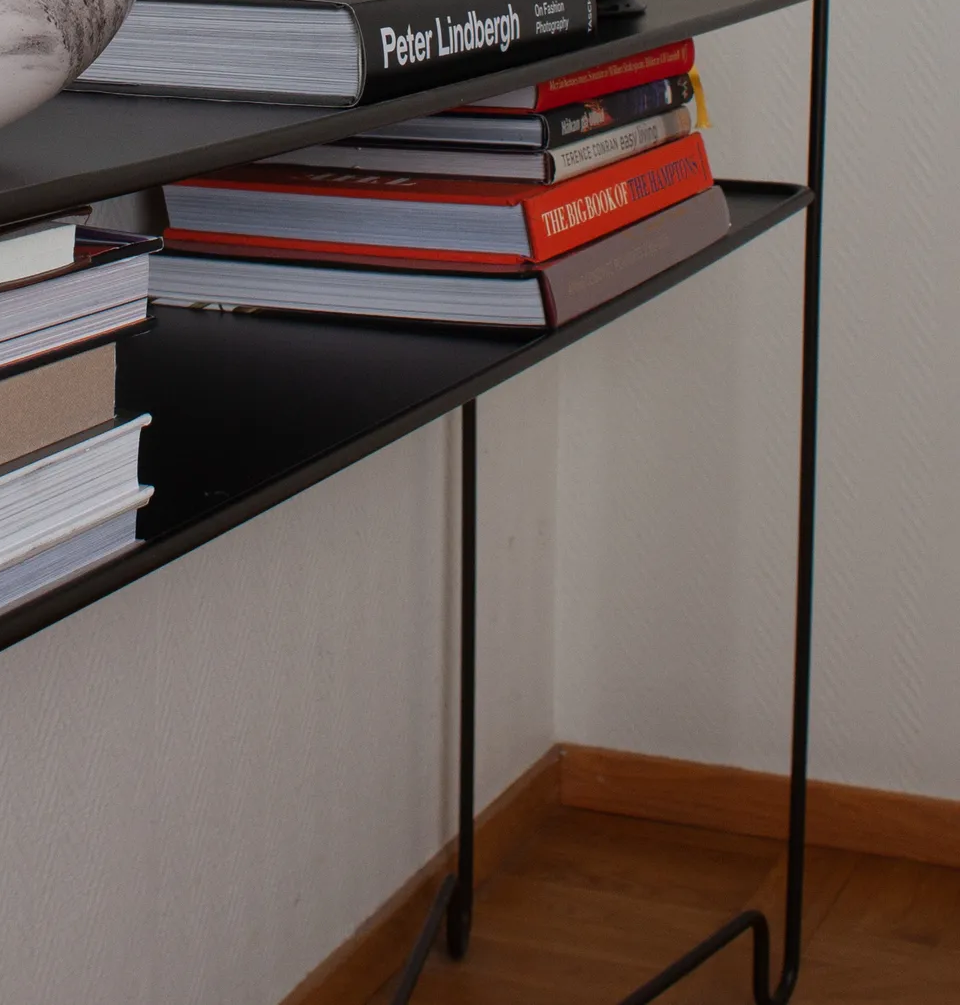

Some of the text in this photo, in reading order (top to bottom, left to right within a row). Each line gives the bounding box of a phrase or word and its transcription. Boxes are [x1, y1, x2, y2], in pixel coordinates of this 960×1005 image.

[534, 0, 565, 17] On Fashion
[535, 16, 569, 34] Photography
[380, 3, 521, 68] Peter Lindbergh
[561, 145, 592, 167] TERENCE
[592, 140, 619, 157] CONRAN
[619, 132, 638, 151] easy
[541, 157, 699, 237] THE BIG BOOK OF THE HAMPTONS
